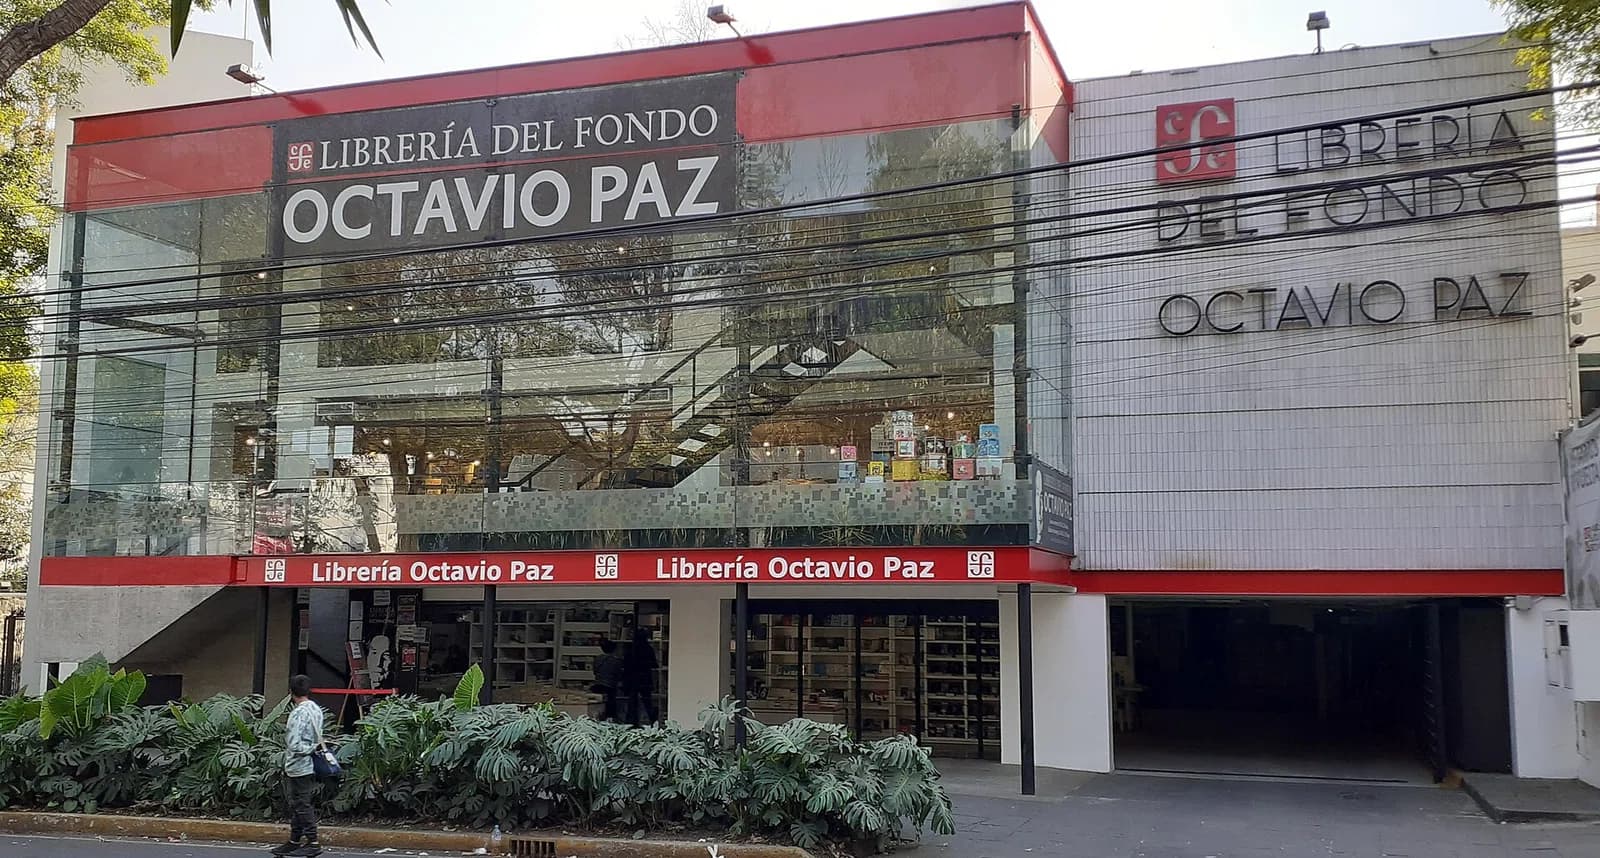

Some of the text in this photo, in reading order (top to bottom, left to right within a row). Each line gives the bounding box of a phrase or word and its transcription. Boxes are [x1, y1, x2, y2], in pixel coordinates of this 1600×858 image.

[319, 104, 719, 170] LIBRERÍA DEL FONDO
[282, 155, 720, 244] OCTAVIO PAZ
[1157, 170, 1527, 241] DEL FONDO
[1158, 271, 1533, 336] OCTAVIO PAZ
[312, 560, 555, 582] Librería Octavio Paz
[656, 556, 935, 579] Librería Octavio Paz
